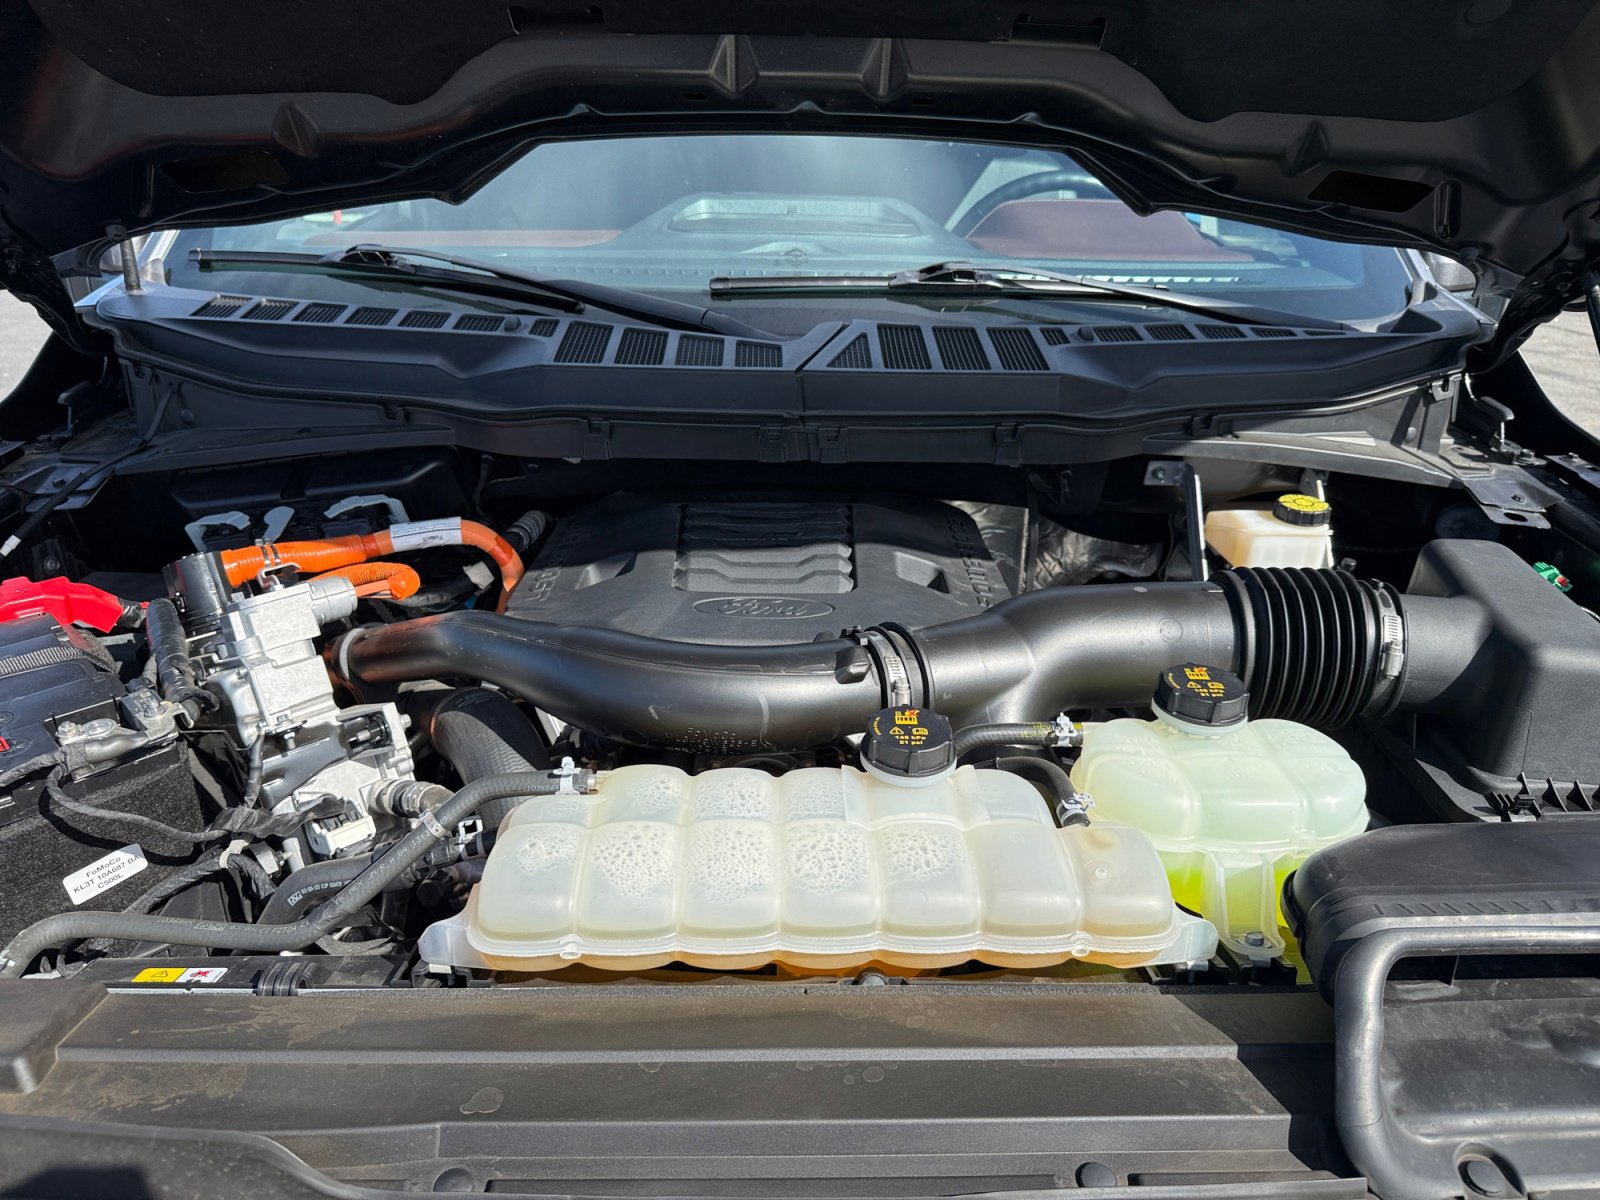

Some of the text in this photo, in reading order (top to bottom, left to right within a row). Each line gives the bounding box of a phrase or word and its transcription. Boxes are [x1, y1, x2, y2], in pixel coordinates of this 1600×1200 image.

[717, 598, 811, 616] Ford
[73, 855, 140, 893] KL3T 10A687 BA
[86, 856, 121, 878] FoMoCo
[97, 873, 124, 889] C500L
